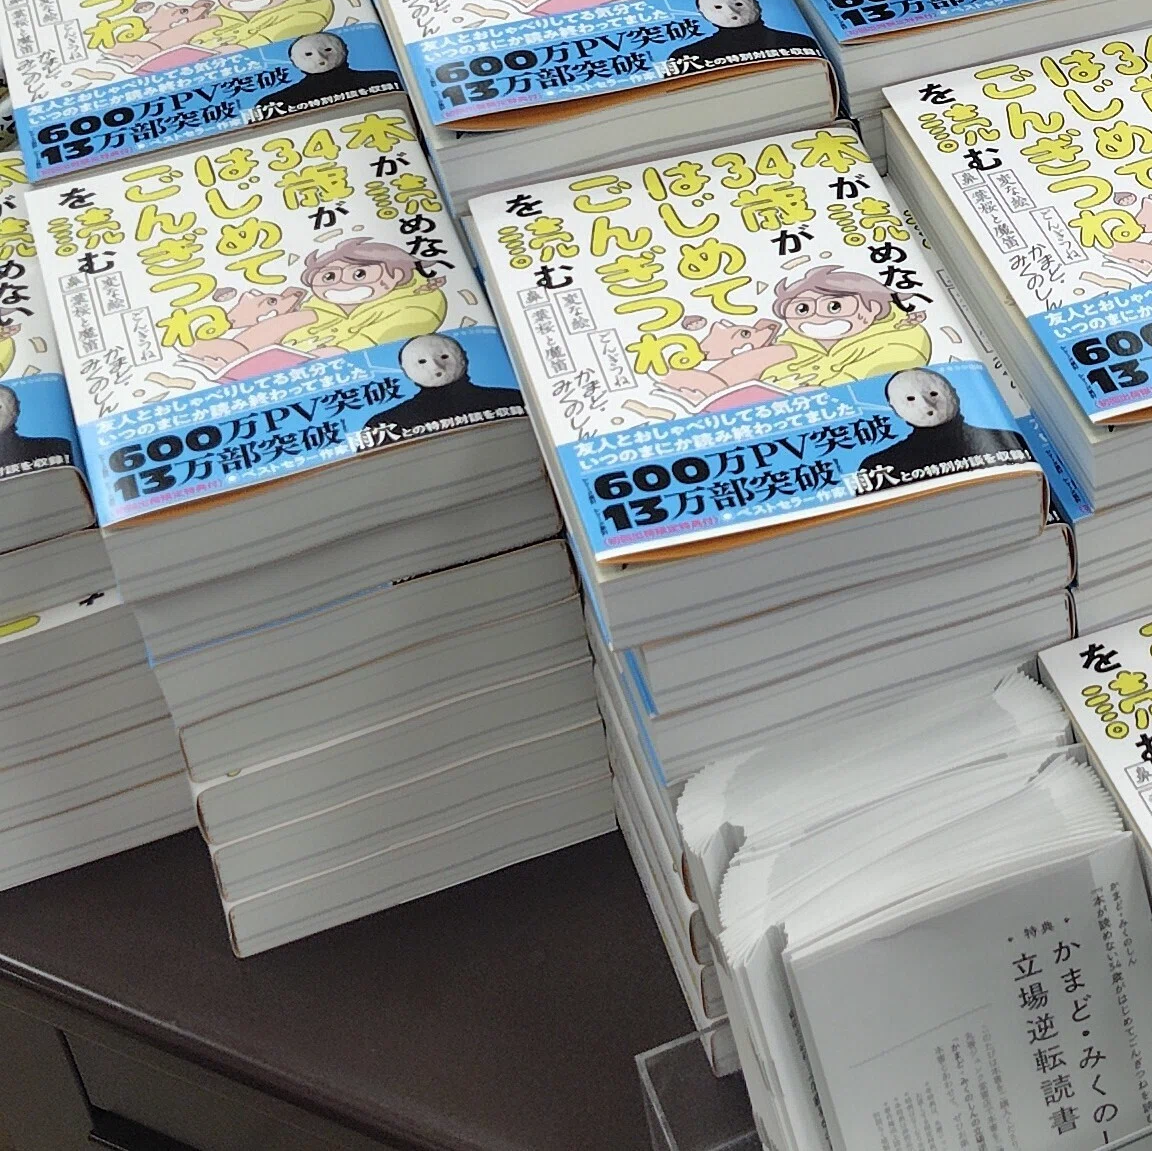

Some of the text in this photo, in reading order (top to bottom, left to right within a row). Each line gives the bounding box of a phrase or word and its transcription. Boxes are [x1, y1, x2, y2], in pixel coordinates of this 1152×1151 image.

[434, 18, 703, 83] 600万PV突破
[38, 65, 291, 143] 600万PV突破
[917, 82, 1001, 171] を読む
[261, 132, 350, 230] 34歳が
[337, 119, 452, 277] 本が読めない
[711, 146, 814, 254] 34歳が
[974, 65, 1144, 248] ごんぎつね
[51, 186, 123, 274] を読む
[123, 166, 231, 348] ごんぎつね
[193, 151, 285, 286] はじめて
[499, 193, 578, 290] を読む
[642, 162, 755, 313] はじめて
[792, 134, 932, 311] 本が読めない
[569, 175, 705, 375] ごんぎつね
[107, 375, 406, 471] 600万PV突破
[112, 420, 344, 500] 13万部突破
[594, 415, 897, 500] 600万PV突破
[603, 459, 838, 530] 13万部突破
[1011, 952, 1081, 1136] 立場逆転読書
